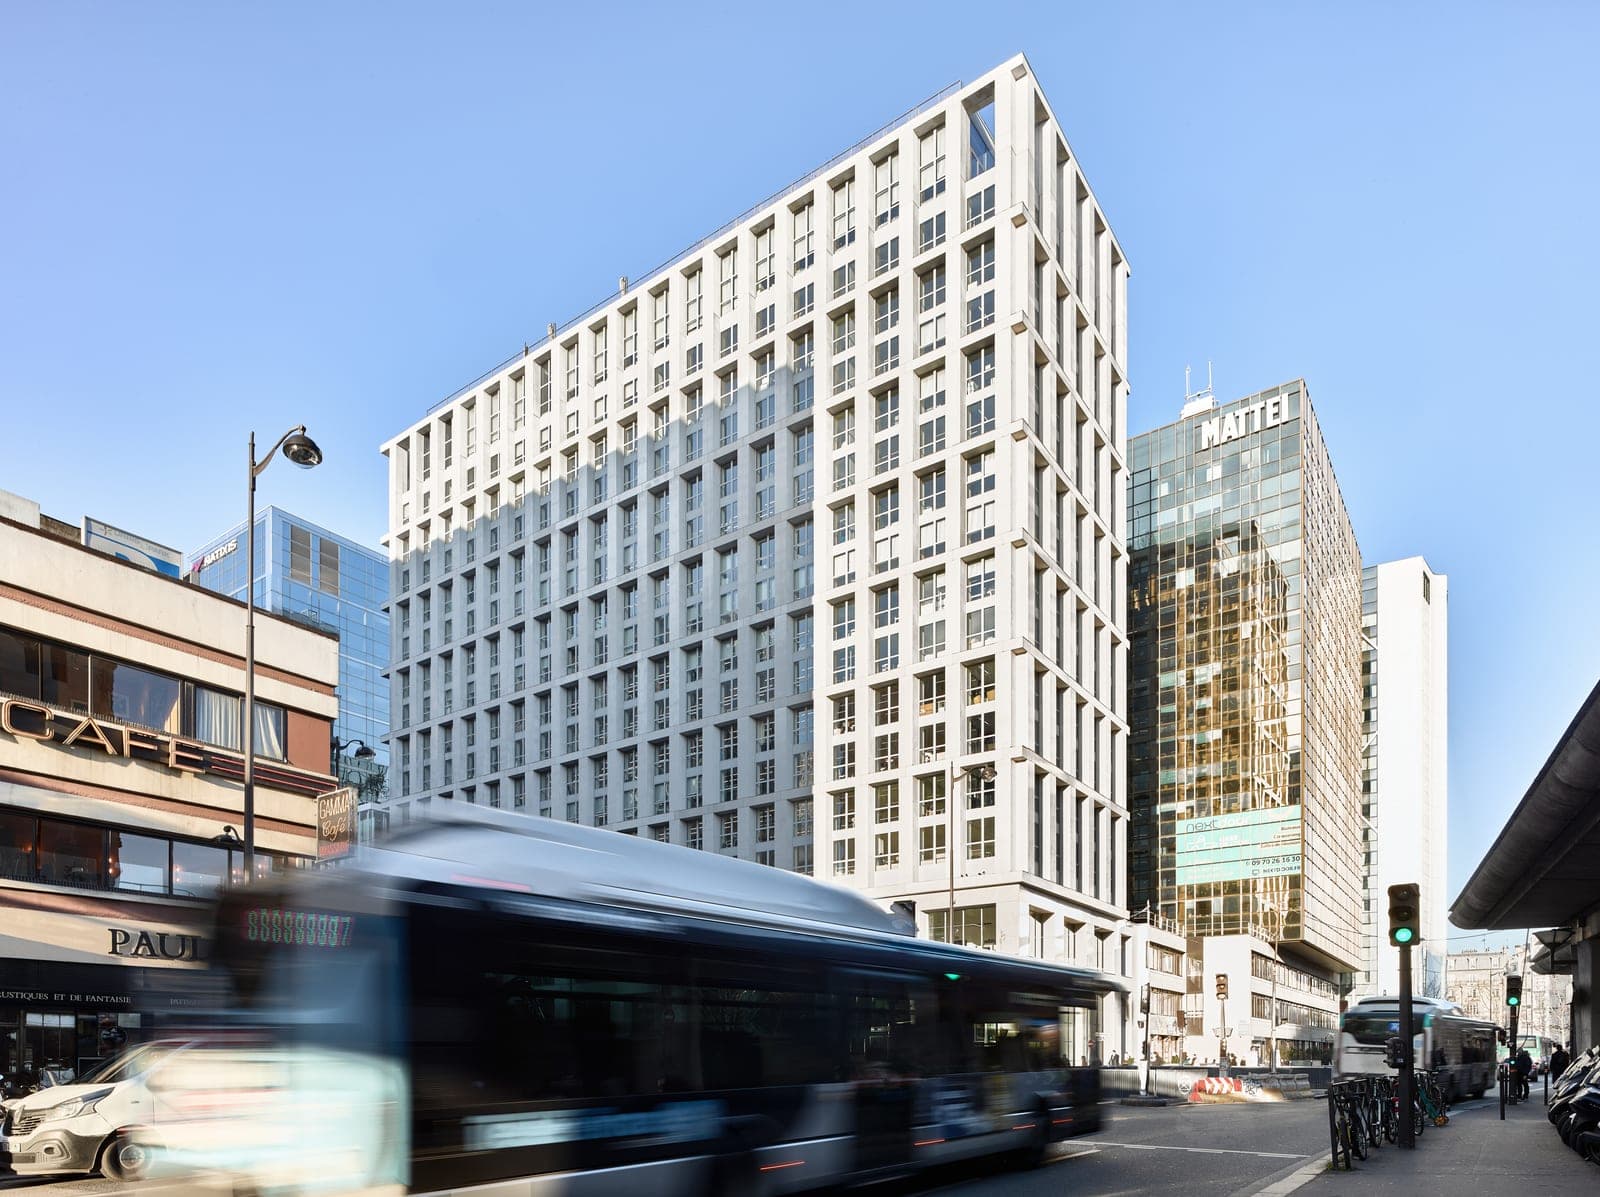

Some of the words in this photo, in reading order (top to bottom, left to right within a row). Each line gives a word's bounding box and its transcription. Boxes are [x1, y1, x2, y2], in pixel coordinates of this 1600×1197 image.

[1201, 392, 1289, 450] MATTEI
[2, 700, 206, 774] CAFE
[320, 793, 349, 819] GAMMA
[322, 817, 346, 841] Café
[0, 991, 49, 1001] USTIQUES
[54, 993, 66, 1001] ET
[70, 994, 82, 1002] DE
[85, 994, 132, 1004] FANTAISIE
